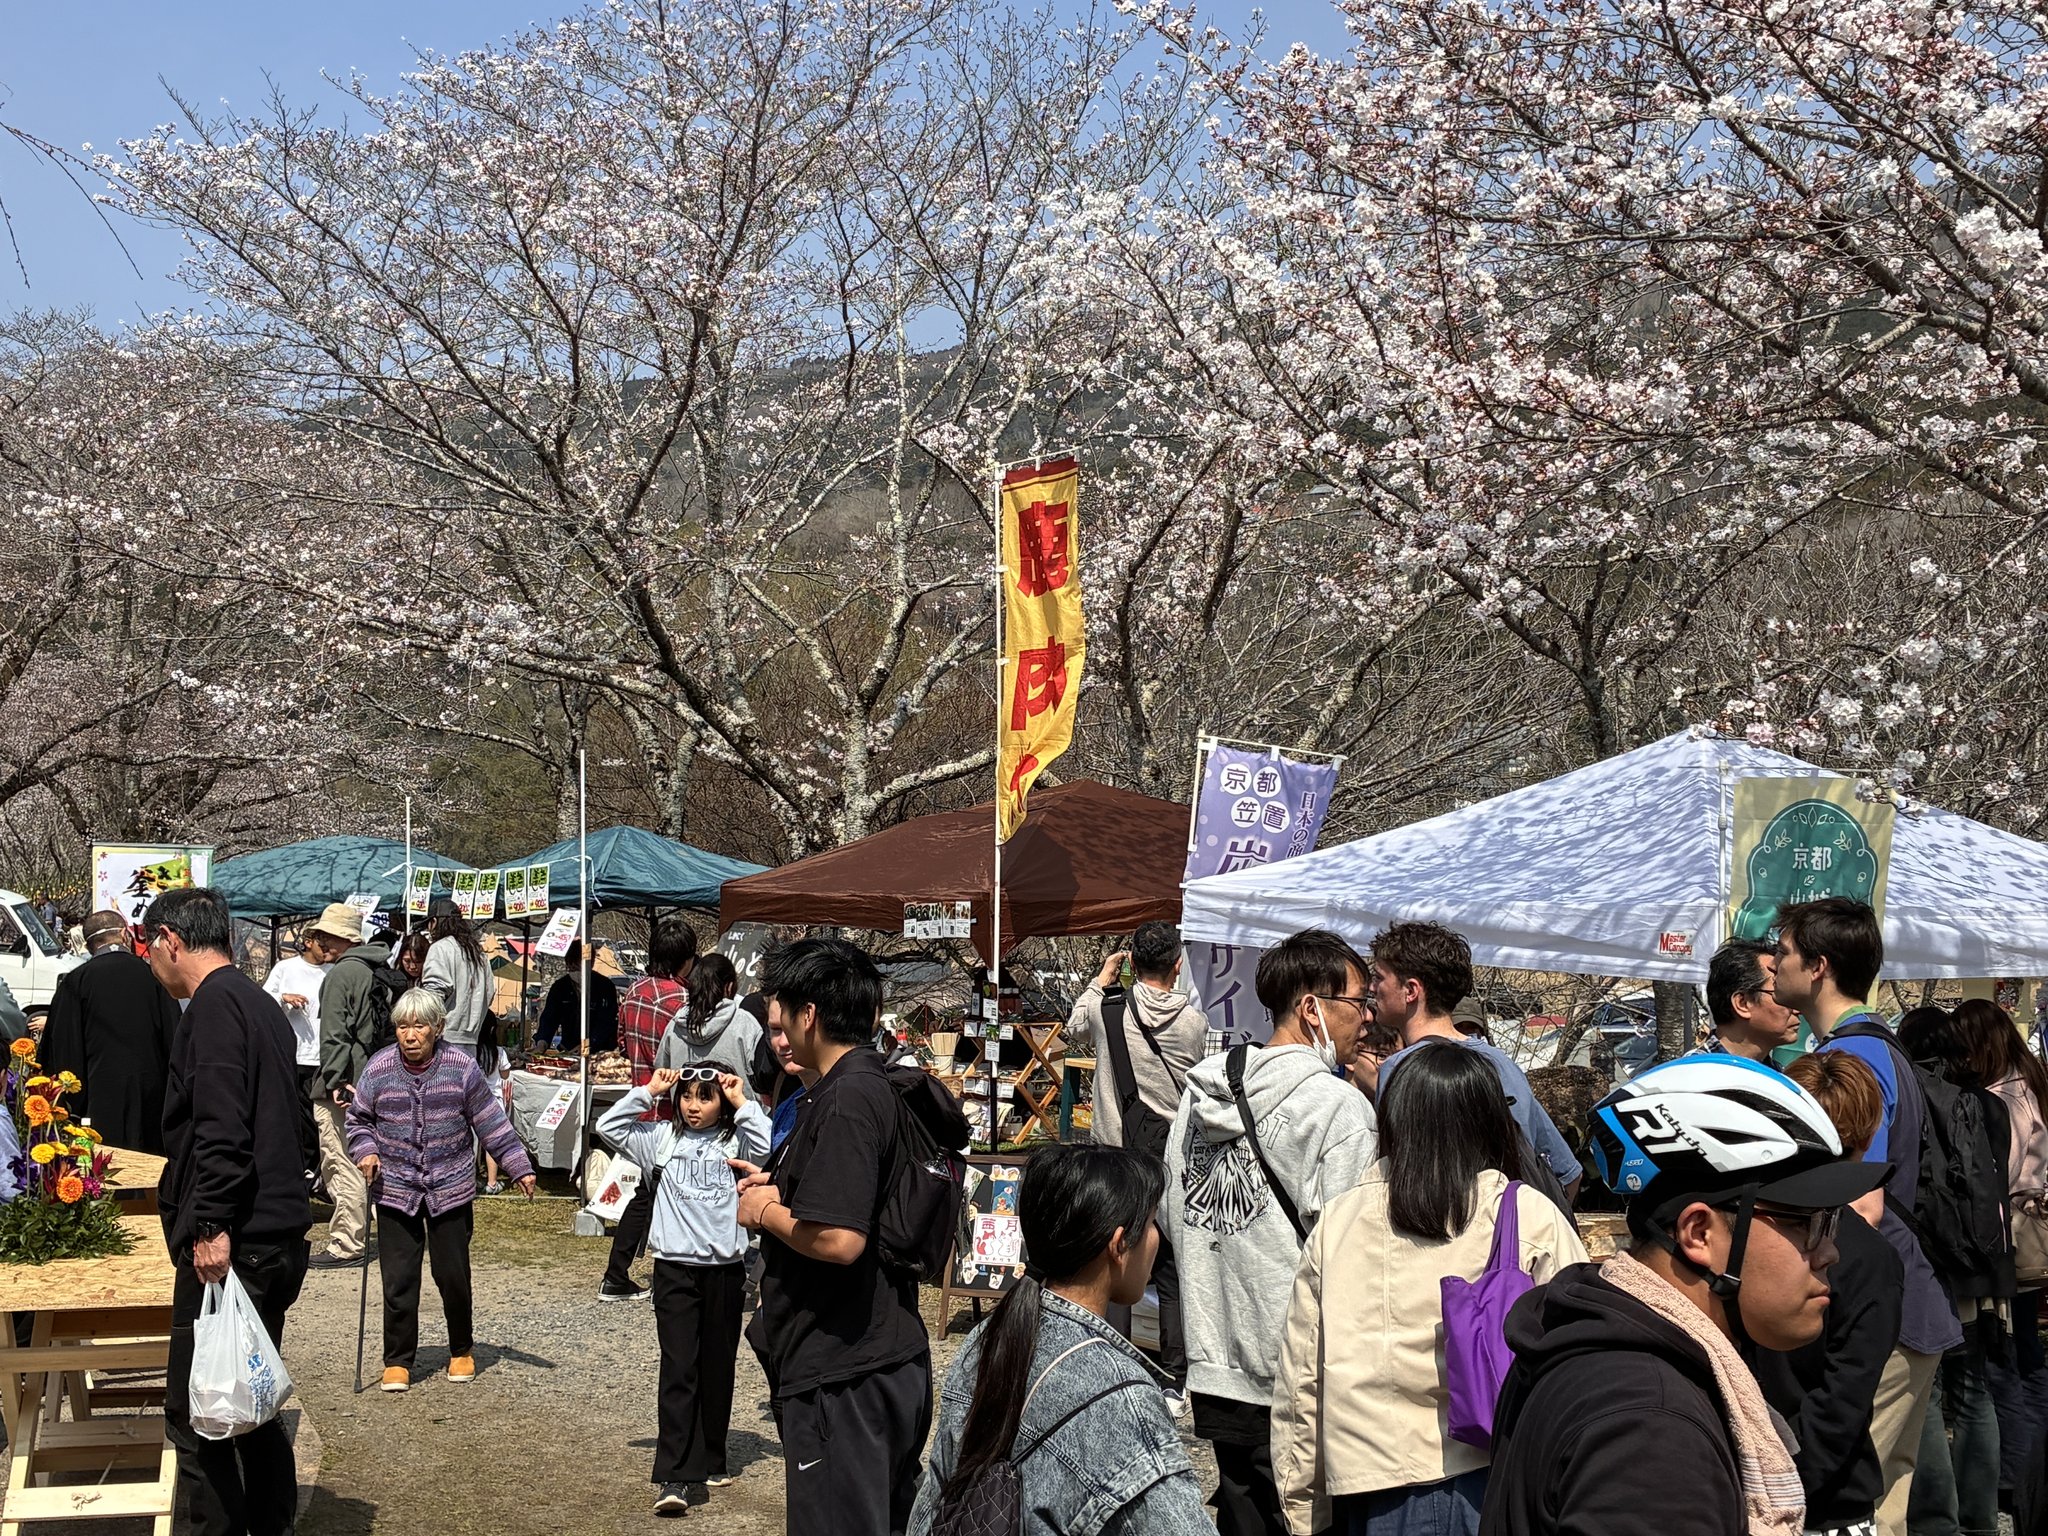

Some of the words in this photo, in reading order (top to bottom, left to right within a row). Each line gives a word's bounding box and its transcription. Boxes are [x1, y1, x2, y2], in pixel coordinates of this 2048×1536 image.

[1223, 767, 1278, 794] 京都
[1234, 800, 1286, 830] 笠置
[1792, 842, 1833, 871] 京都
[1660, 932, 1687, 951] Master
[1655, 1103, 1708, 1157] Kabuto
